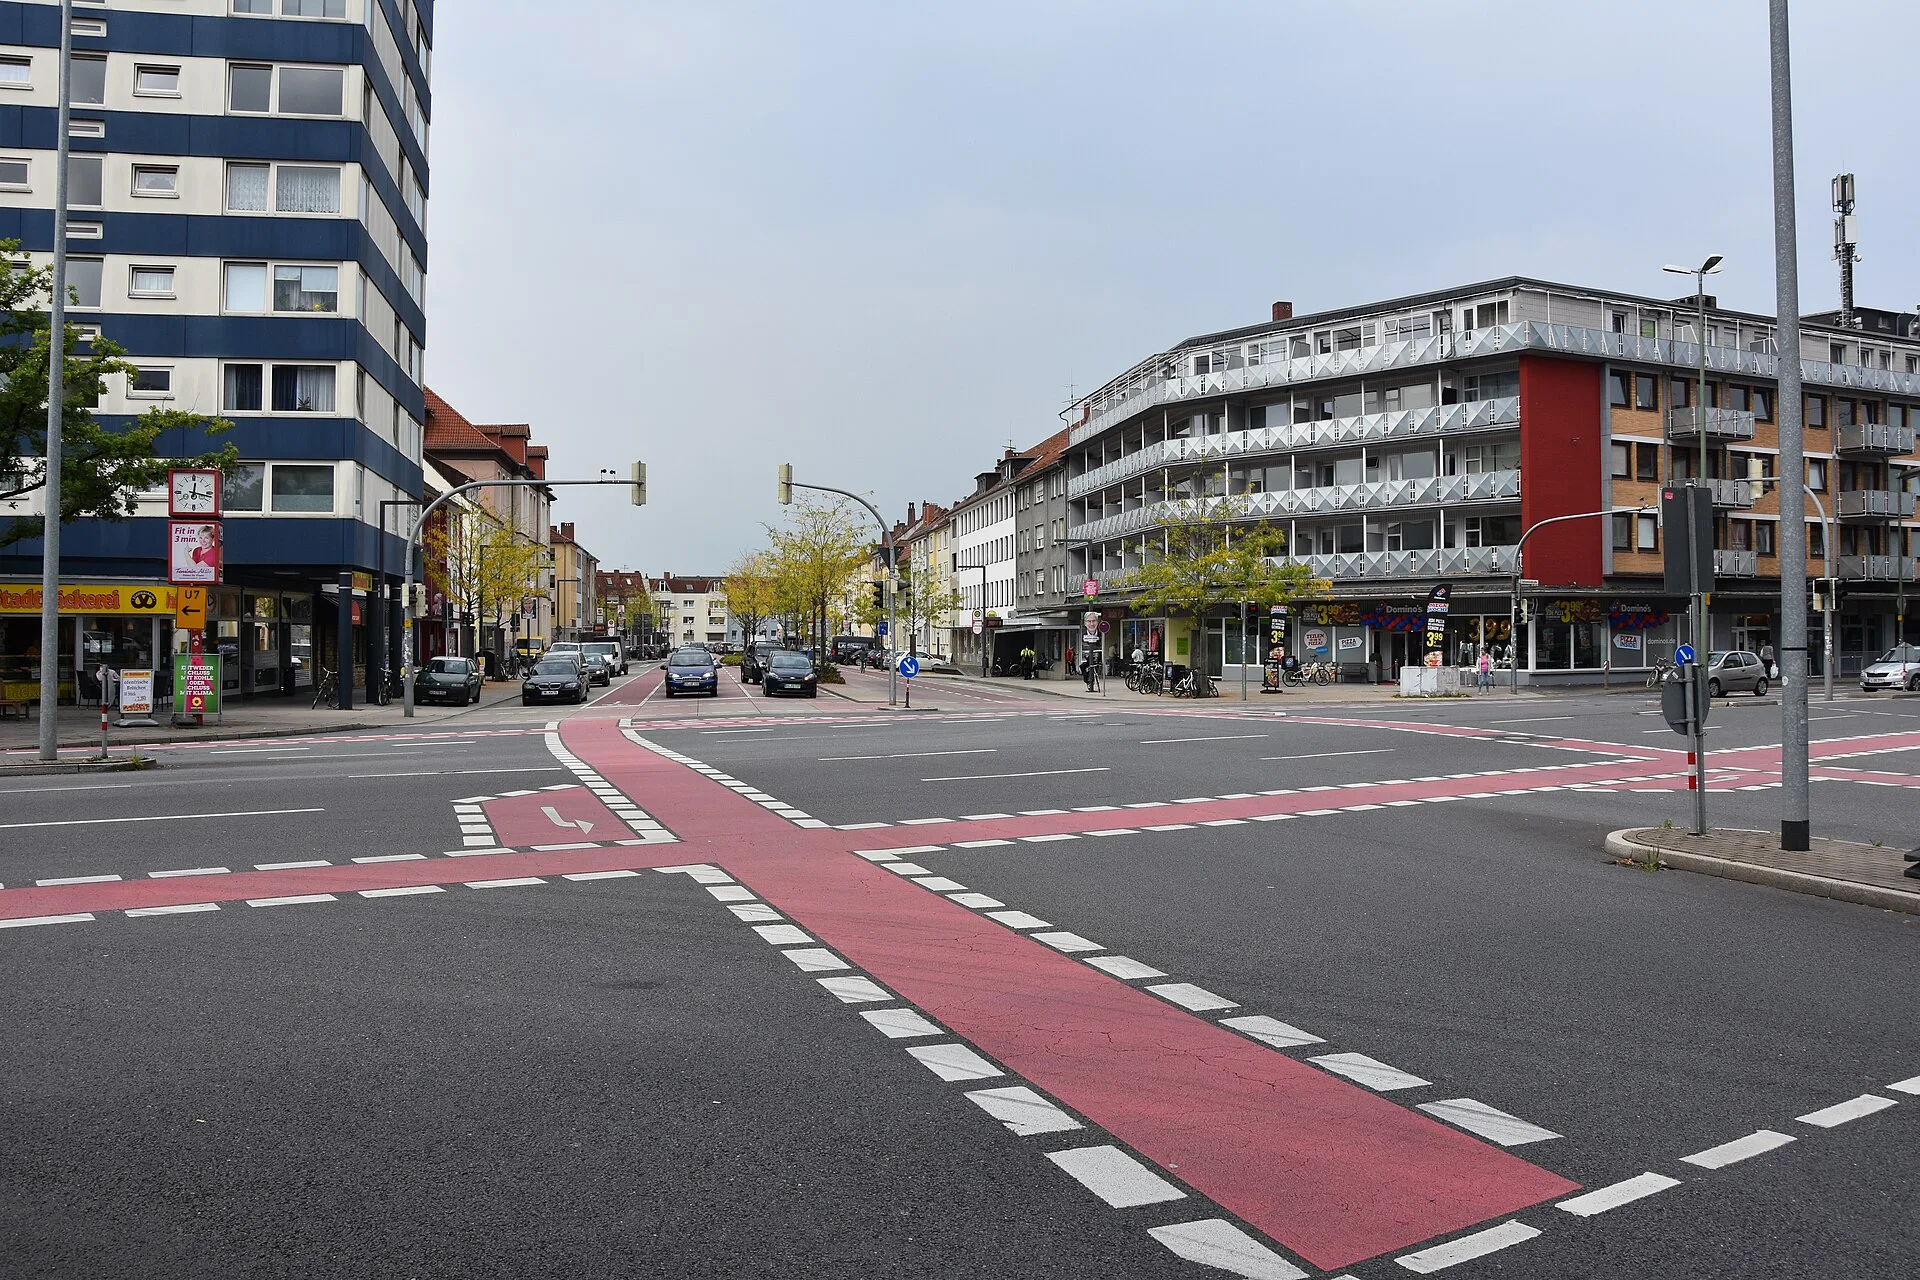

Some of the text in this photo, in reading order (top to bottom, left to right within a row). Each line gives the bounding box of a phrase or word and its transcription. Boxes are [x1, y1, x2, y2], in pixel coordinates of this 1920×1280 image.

[174, 527, 195, 535] Fit in
[180, 535, 198, 543] min.
[0, 588, 120, 609] tadtäckerei
[1386, 604, 1423, 613] Domino's
[1620, 603, 1652, 613] Domino's
[1647, 637, 1676, 645] dominos.de
